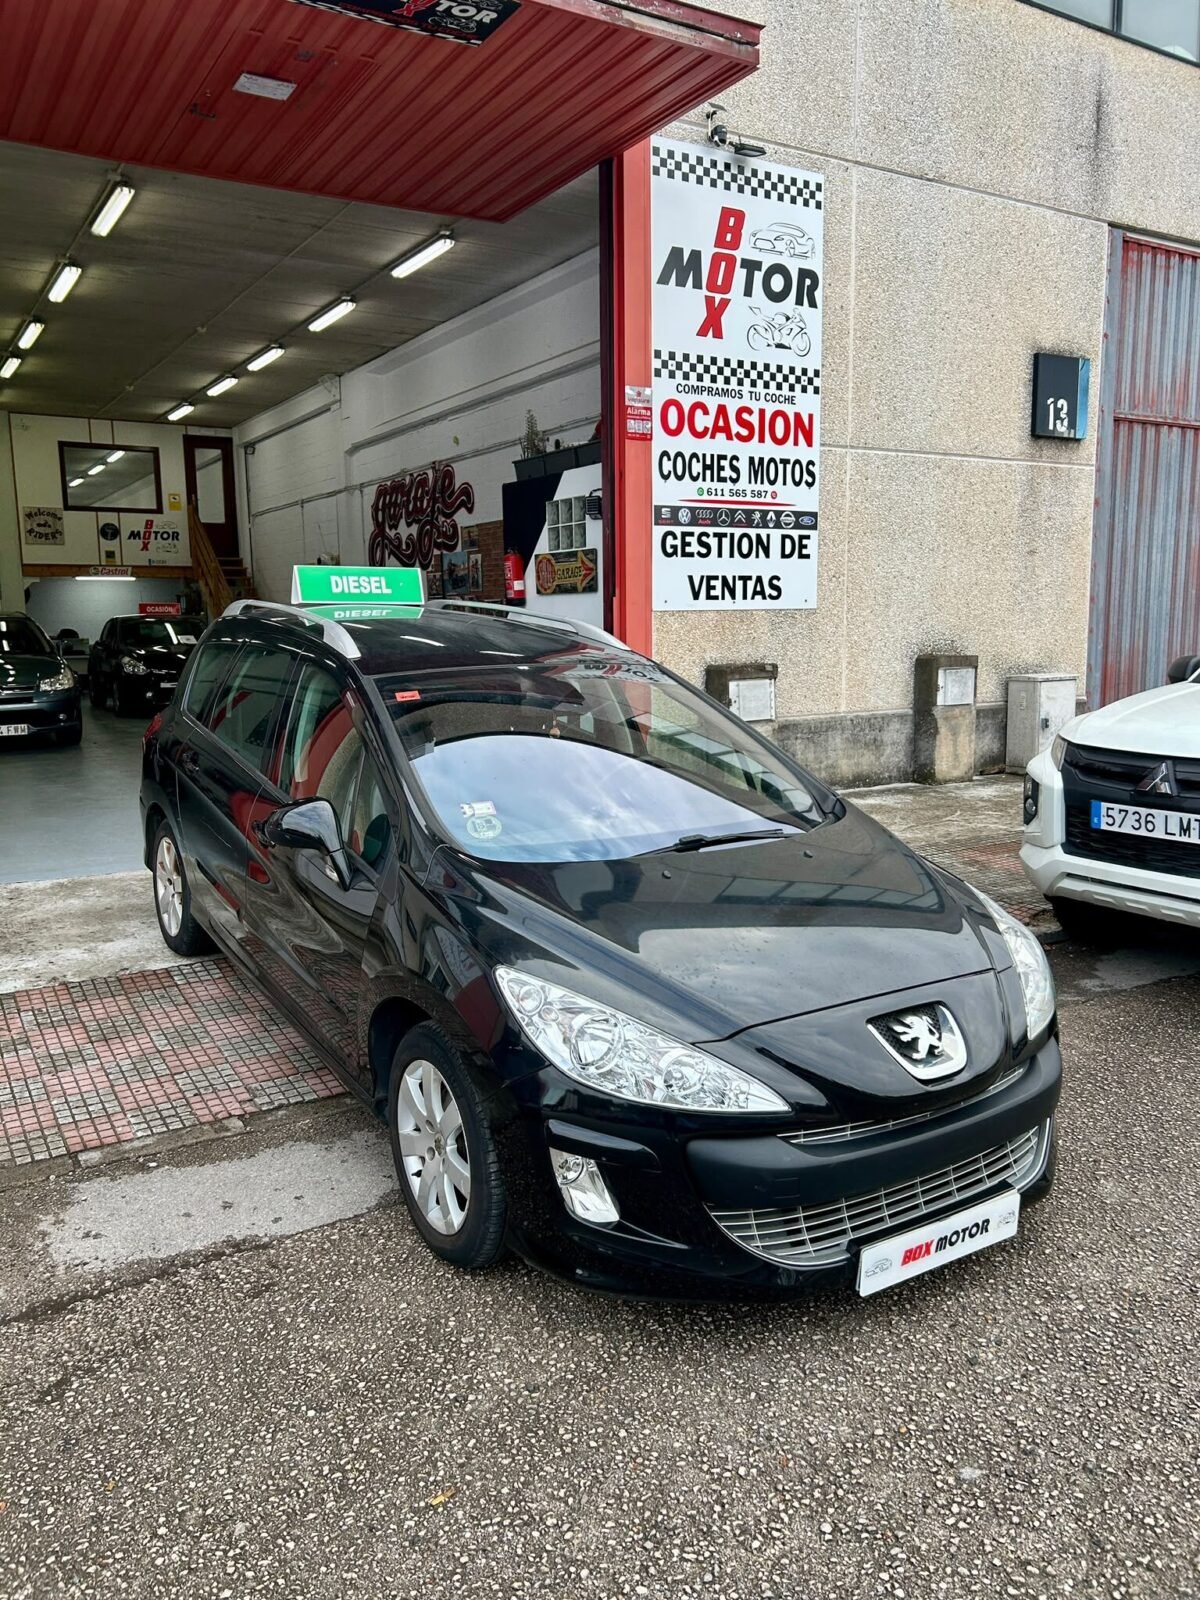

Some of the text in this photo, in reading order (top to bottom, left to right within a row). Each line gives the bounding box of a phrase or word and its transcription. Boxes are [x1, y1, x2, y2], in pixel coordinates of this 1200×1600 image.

[656, 246, 820, 309] MOTOR
[696, 206, 746, 340] BOX
[676, 383, 796, 405] COMPRAMOS TU COCHE
[627, 406, 651, 416] Alarma
[660, 398, 814, 448] OCASION
[1047, 397, 1069, 432] 13
[658, 450, 816, 488] COCHES MOTOS
[706, 487, 769, 499] 611 565 587
[24, 508, 63, 521] Welcome
[26, 528, 63, 540] RIDERS
[661, 530, 810, 559] GESTION DE
[100, 567, 129, 576] Castrol
[556, 565, 583, 580] GARAGE
[330, 575, 392, 594] DIESEL
[688, 574, 782, 600] VENTAS
[1105, 807, 1156, 832] 5736
[901, 1219, 990, 1266] BOX MOTOR
